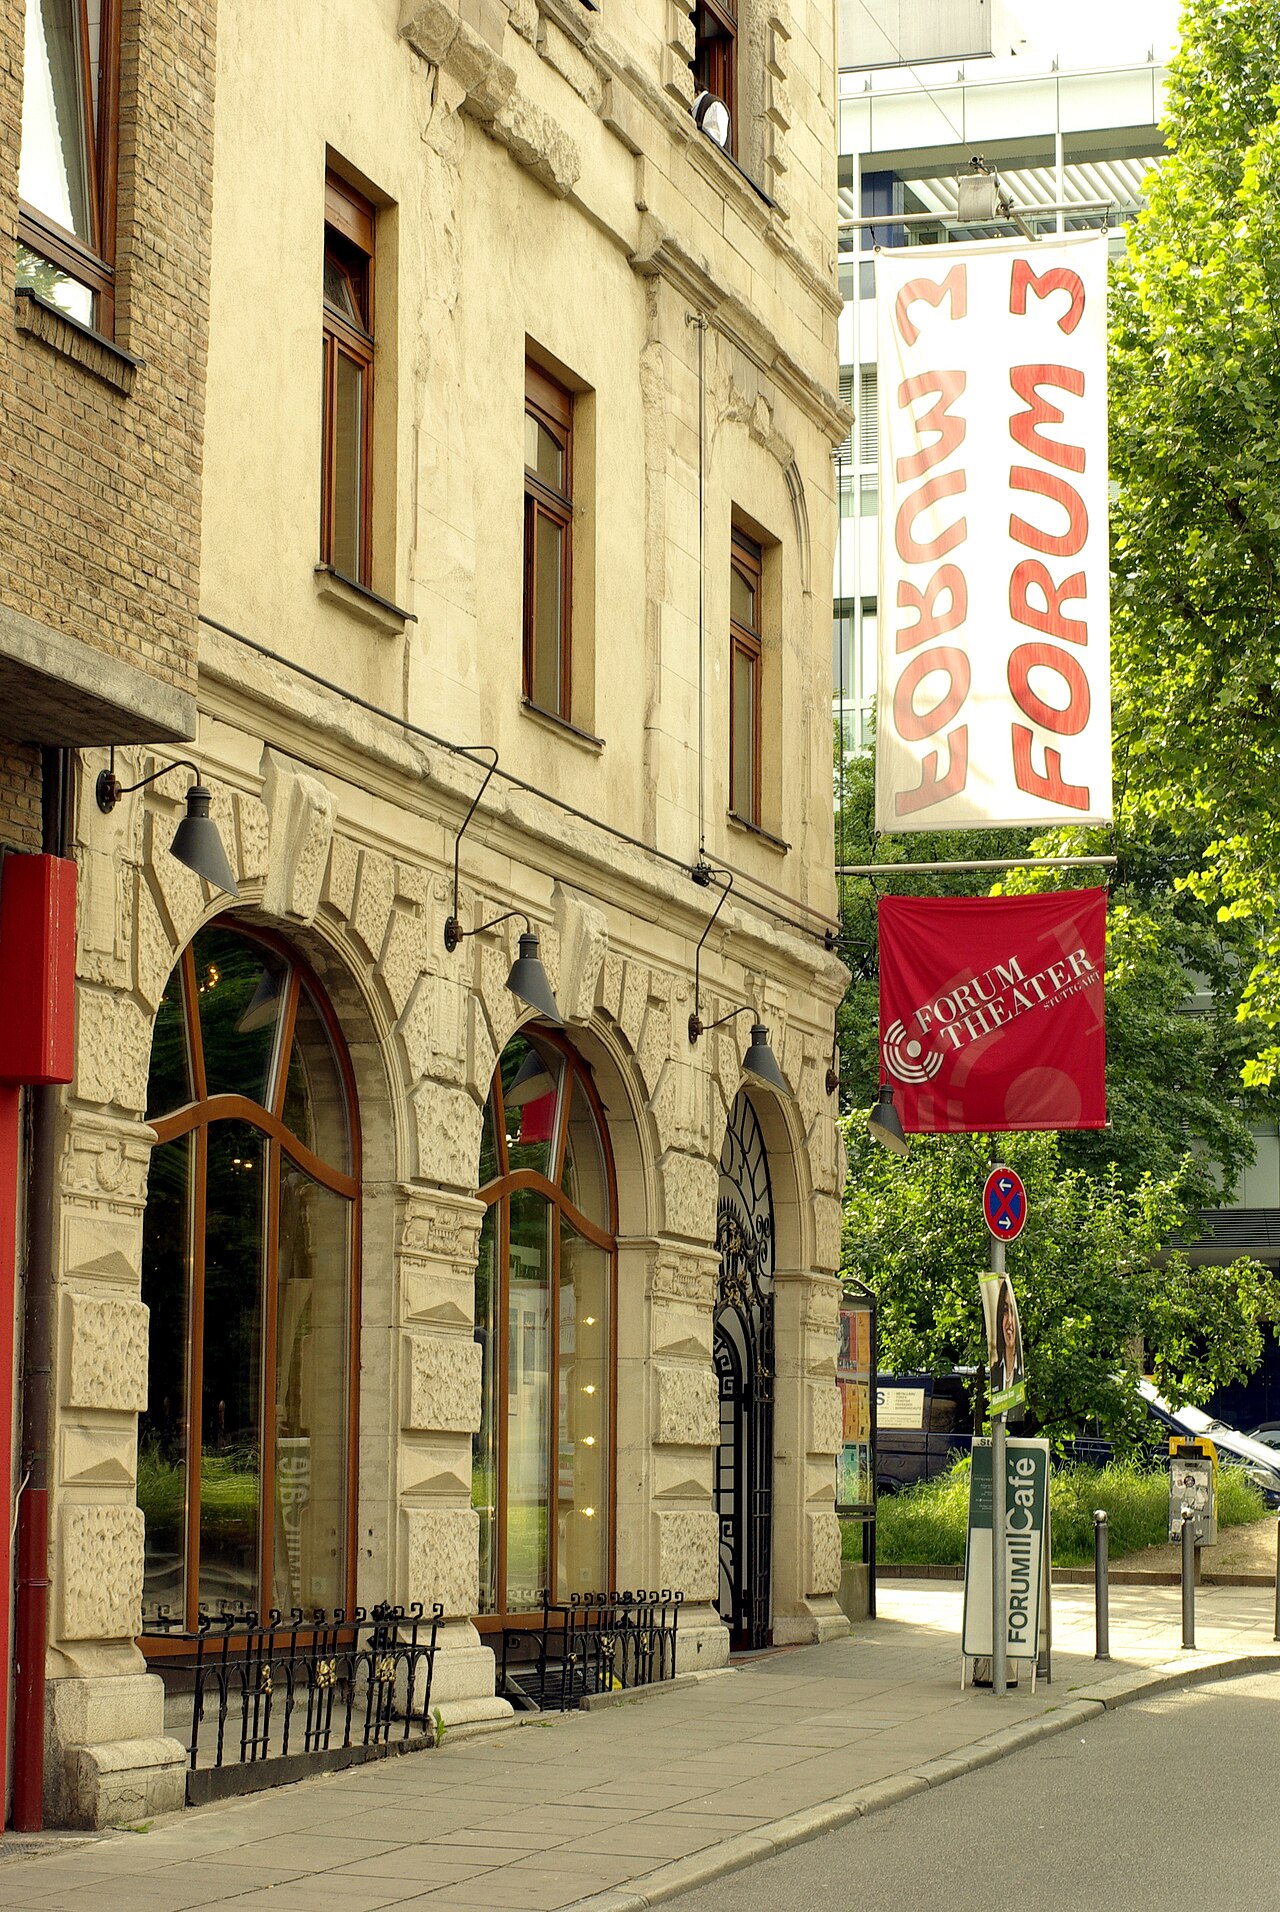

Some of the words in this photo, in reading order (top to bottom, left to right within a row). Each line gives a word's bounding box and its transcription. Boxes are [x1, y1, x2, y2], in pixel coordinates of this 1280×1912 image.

[1009, 258, 1086, 336] 3
[1007, 363, 1090, 812] FORUM
[912, 954, 1028, 1036] FORUM
[939, 948, 1096, 1051] THEATER
[1043, 970, 1101, 1011] STUTTGART
